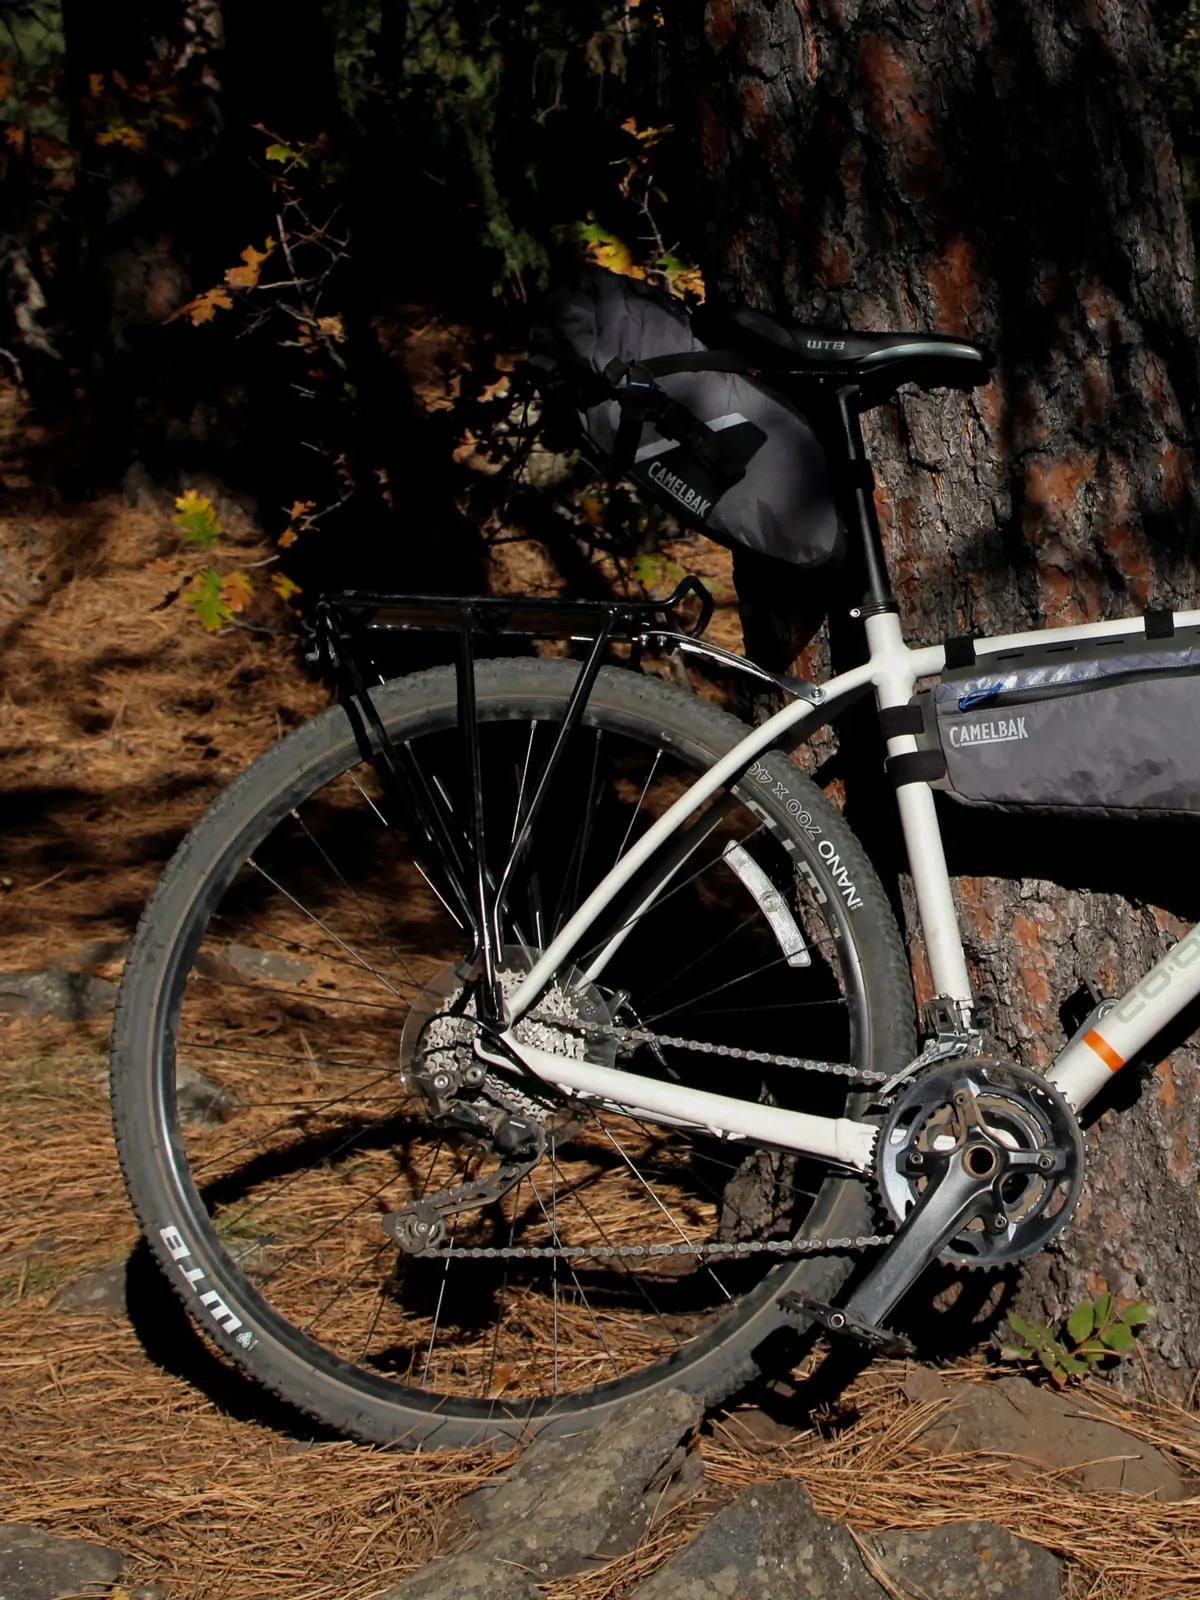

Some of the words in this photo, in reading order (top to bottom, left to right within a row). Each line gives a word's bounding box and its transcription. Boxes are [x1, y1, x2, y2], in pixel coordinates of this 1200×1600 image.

[806, 339, 846, 350] WTB
[648, 460, 712, 518] CAMELBAK
[949, 716, 1029, 748] CAMELBAK
[786, 798, 822, 841] 700
[818, 840, 863, 908] NANO
[160, 1225, 242, 1335] WTB
